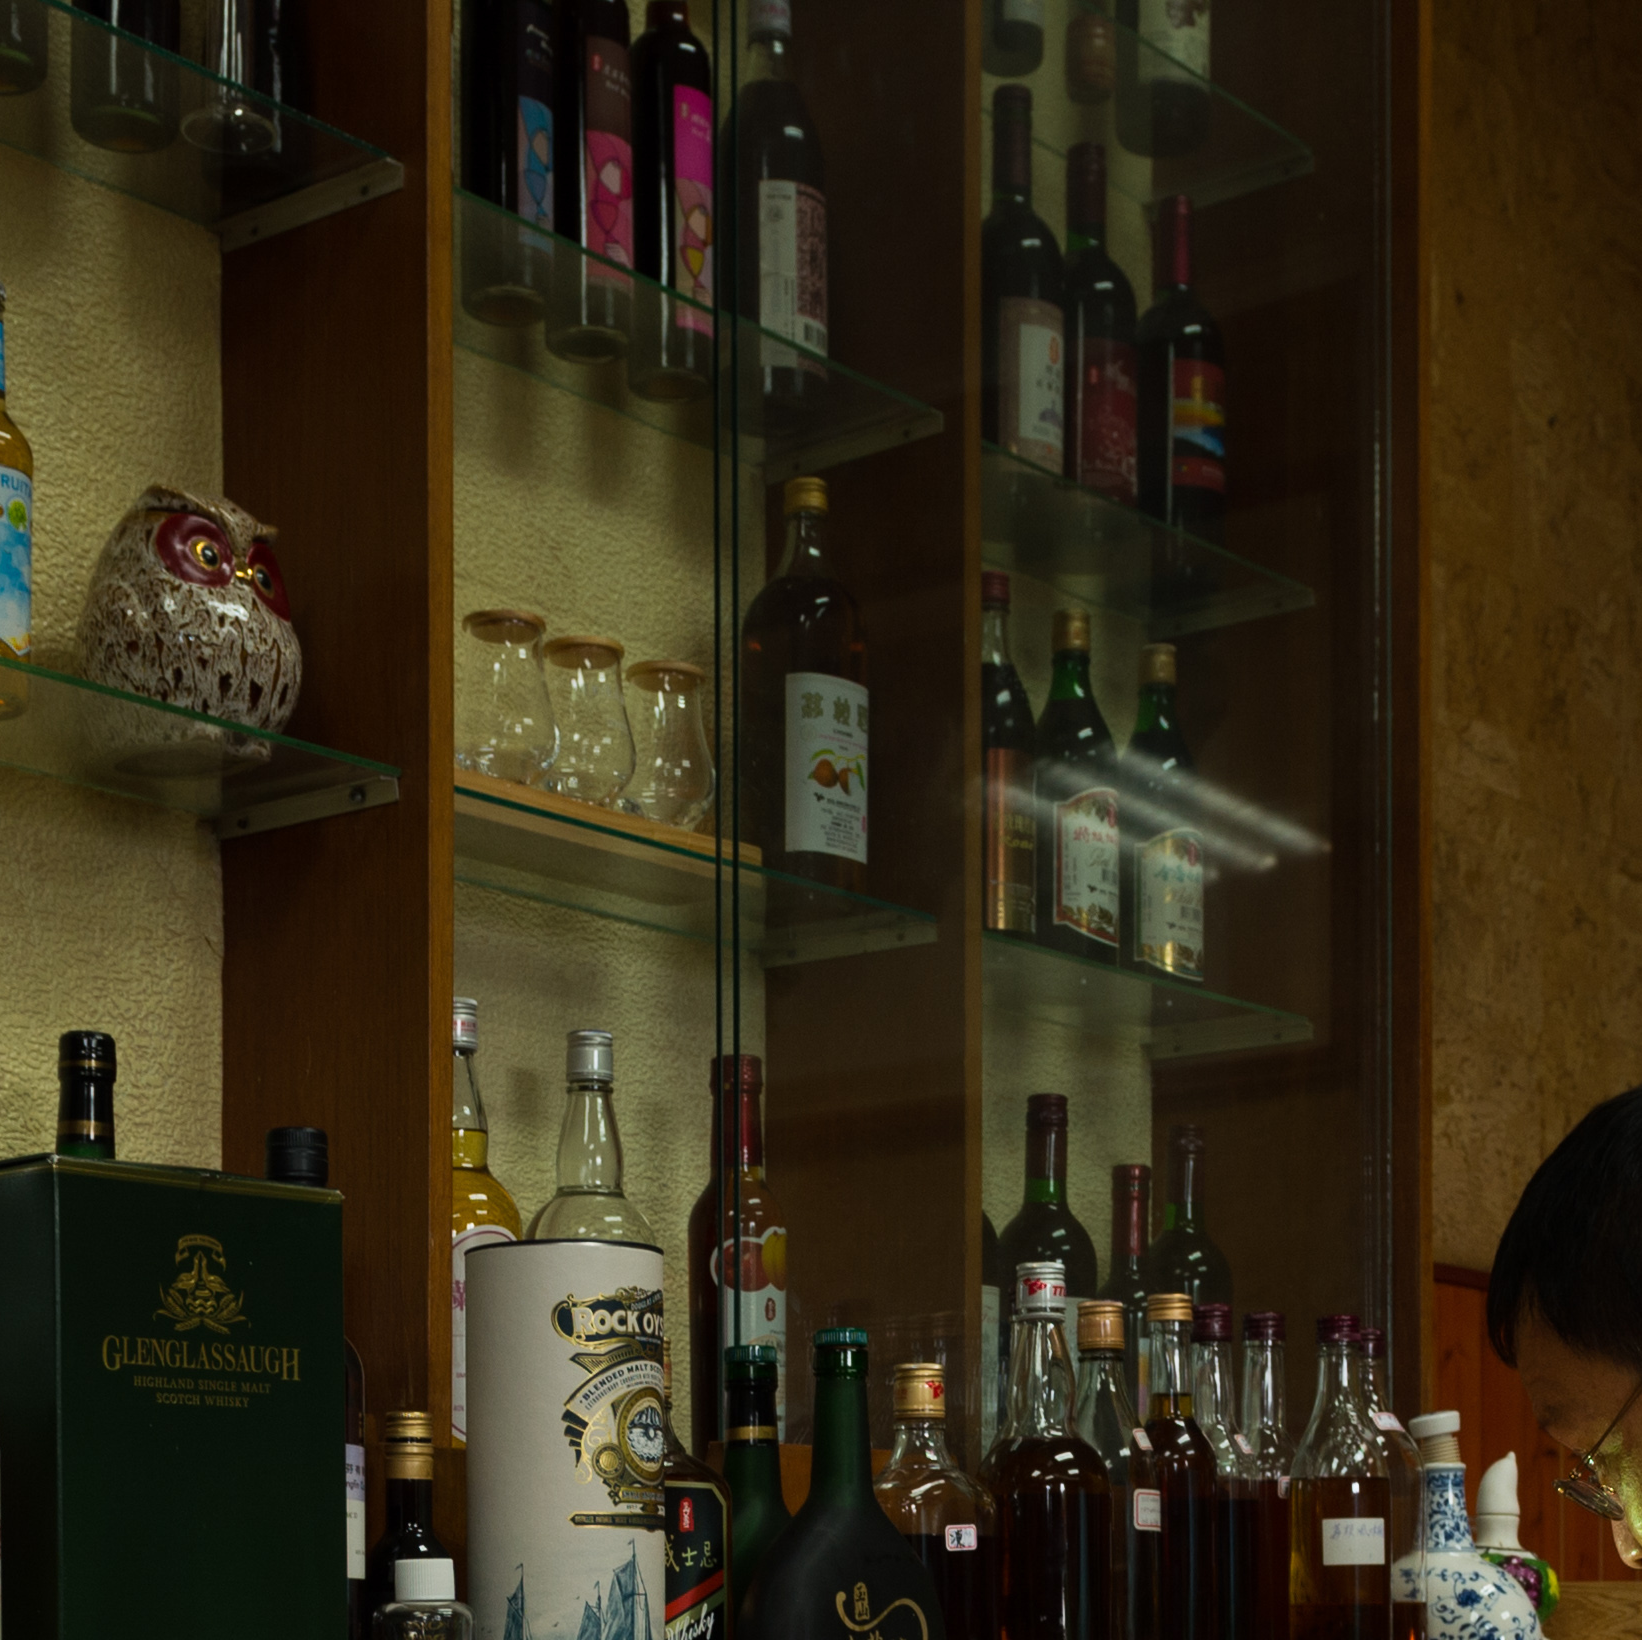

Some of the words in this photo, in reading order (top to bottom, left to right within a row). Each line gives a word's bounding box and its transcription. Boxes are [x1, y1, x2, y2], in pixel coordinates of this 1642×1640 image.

[571, 1307, 641, 1335] ROCK
[101, 1335, 301, 1382] GLENGLASSAUGH
[133, 1375, 195, 1390] HIGHLAND
[198, 1379, 237, 1392] SINGLE
[241, 1381, 271, 1394] MALT
[582, 1369, 625, 1401] BLENDED
[626, 1363, 648, 1373] MALT
[156, 1392, 201, 1406] SCOTCH
[204, 1394, 250, 1409] WHISKY
